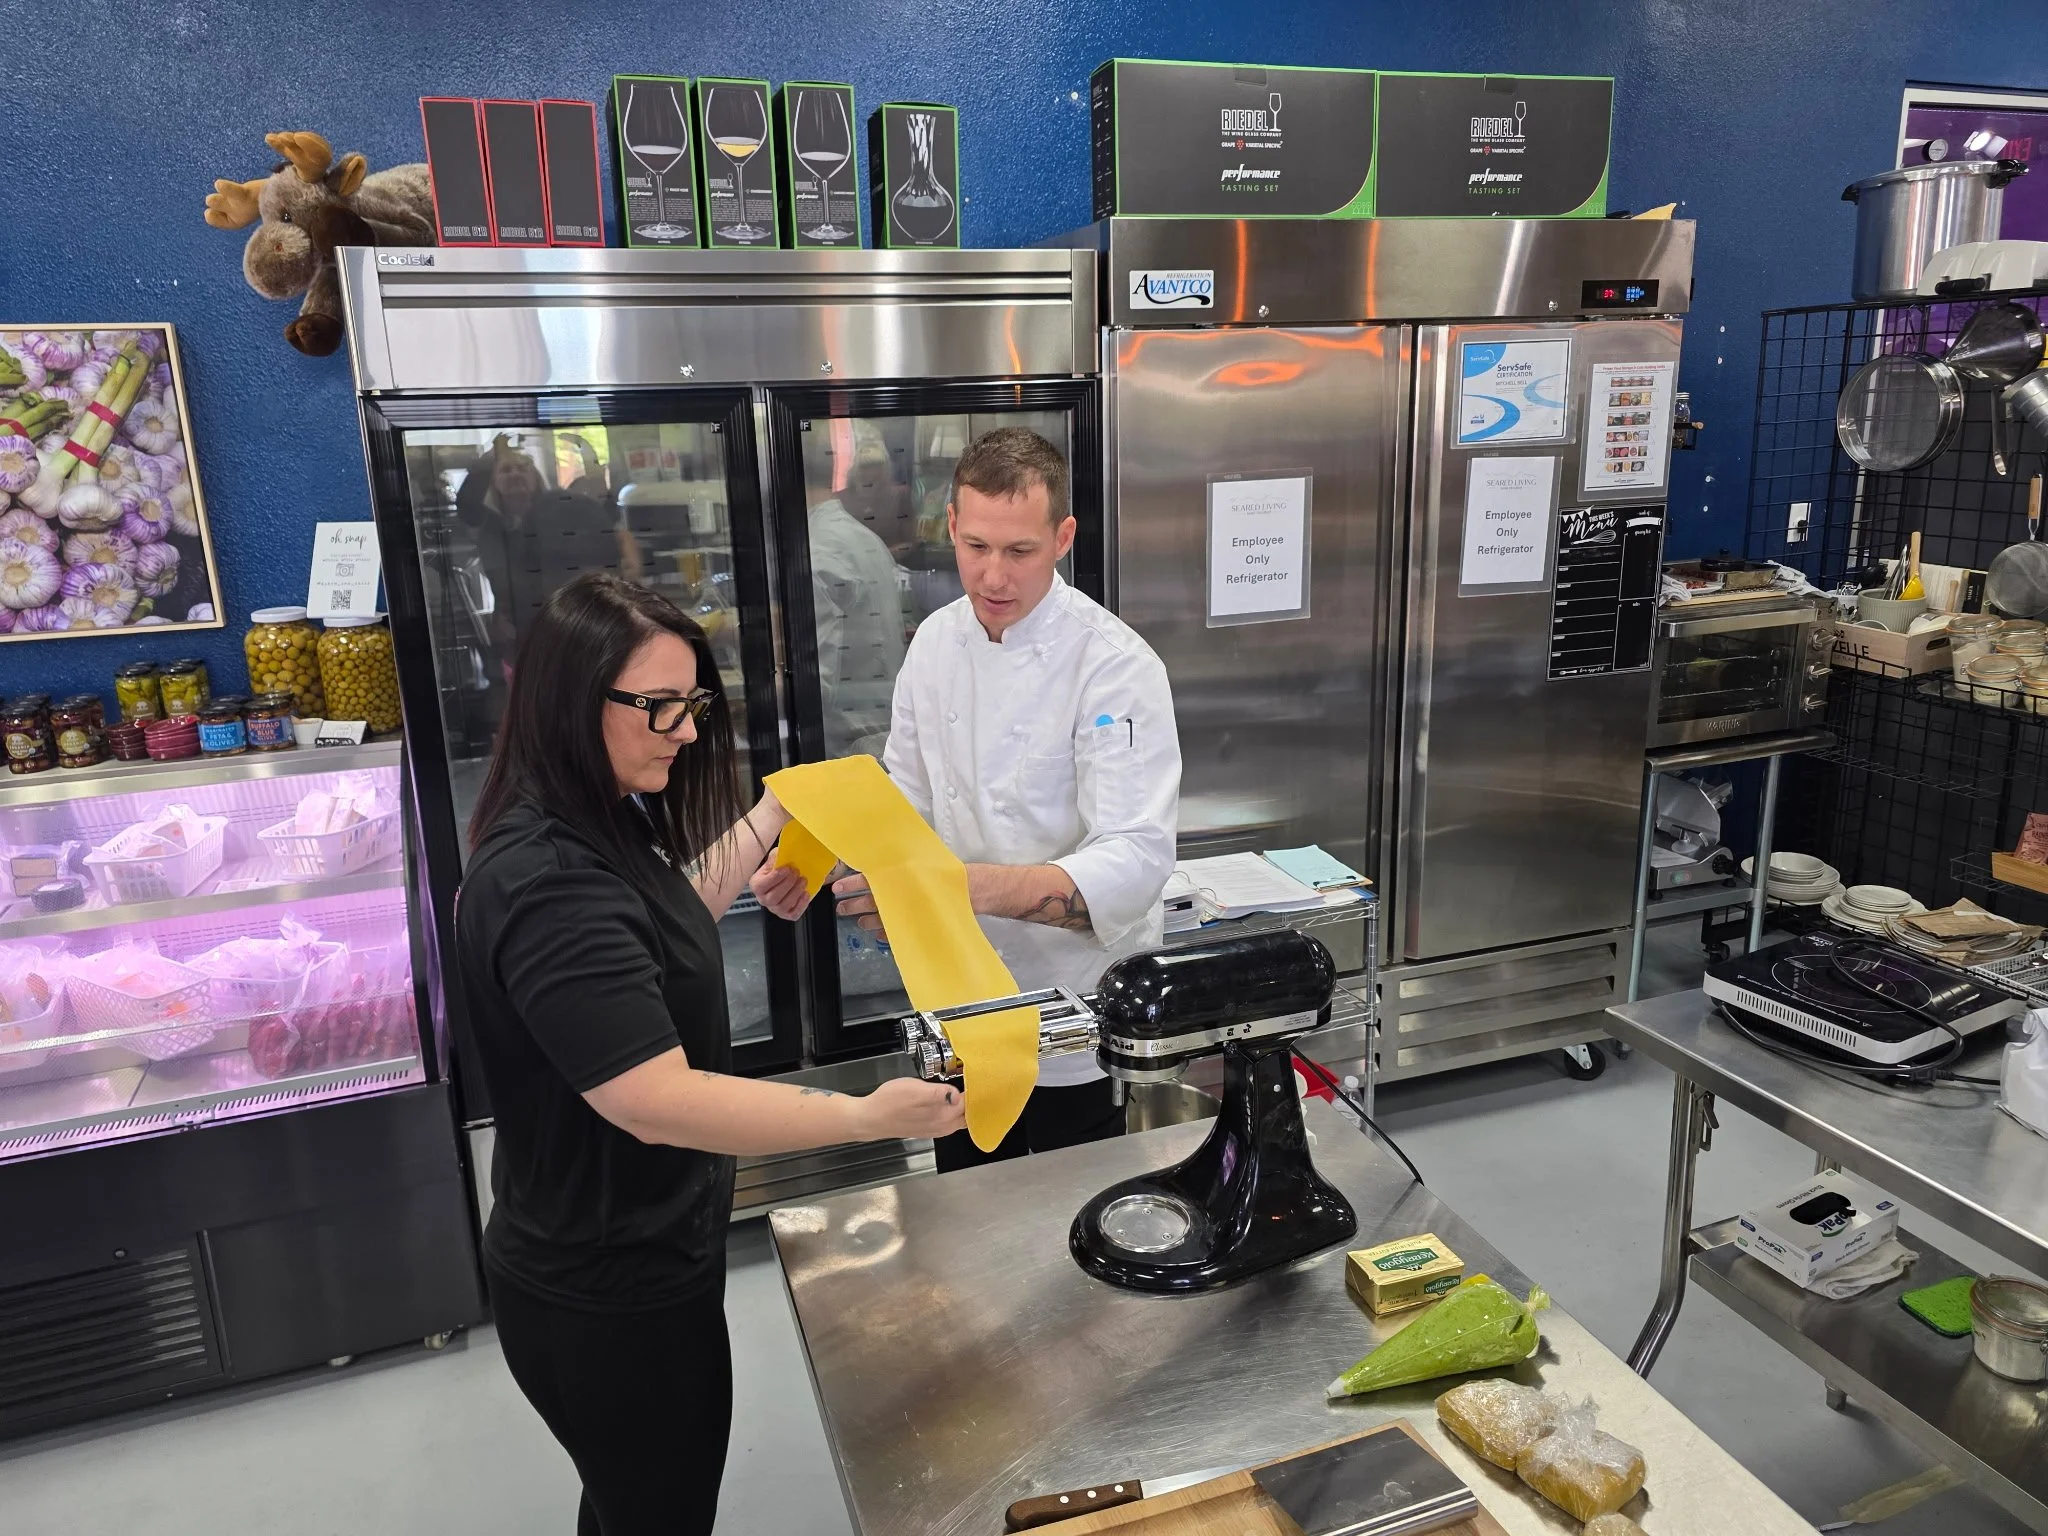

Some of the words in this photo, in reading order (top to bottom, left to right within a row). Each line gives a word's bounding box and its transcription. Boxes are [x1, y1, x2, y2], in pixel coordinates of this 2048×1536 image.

[1222, 109, 1268, 132] RIEDEL
[1471, 118, 1514, 138] RIEDEL
[1221, 164, 1280, 181] performance
[1468, 168, 1522, 184] performance
[378, 253, 435, 266] Coolski
[1132, 274, 1211, 299] AVANTCO
[1498, 362, 1532, 372] ServSafe
[1231, 504, 1260, 512] SEARED
[1262, 502, 1287, 510] LIVING
[1485, 510, 1532, 521] Employee
[1599, 511, 1614, 520] WEEK'S
[1496, 528, 1519, 538] Only
[1563, 518, 1618, 539] Menu
[330, 528, 342, 544] oh
[345, 536, 367, 550] snap
[1232, 536, 1284, 548] Employee
[1478, 545, 1534, 556] Refrigerator
[1245, 554, 1270, 565] Only
[1226, 572, 1288, 584] Refrigerator
[1758, 1236, 1783, 1254] ProPak
